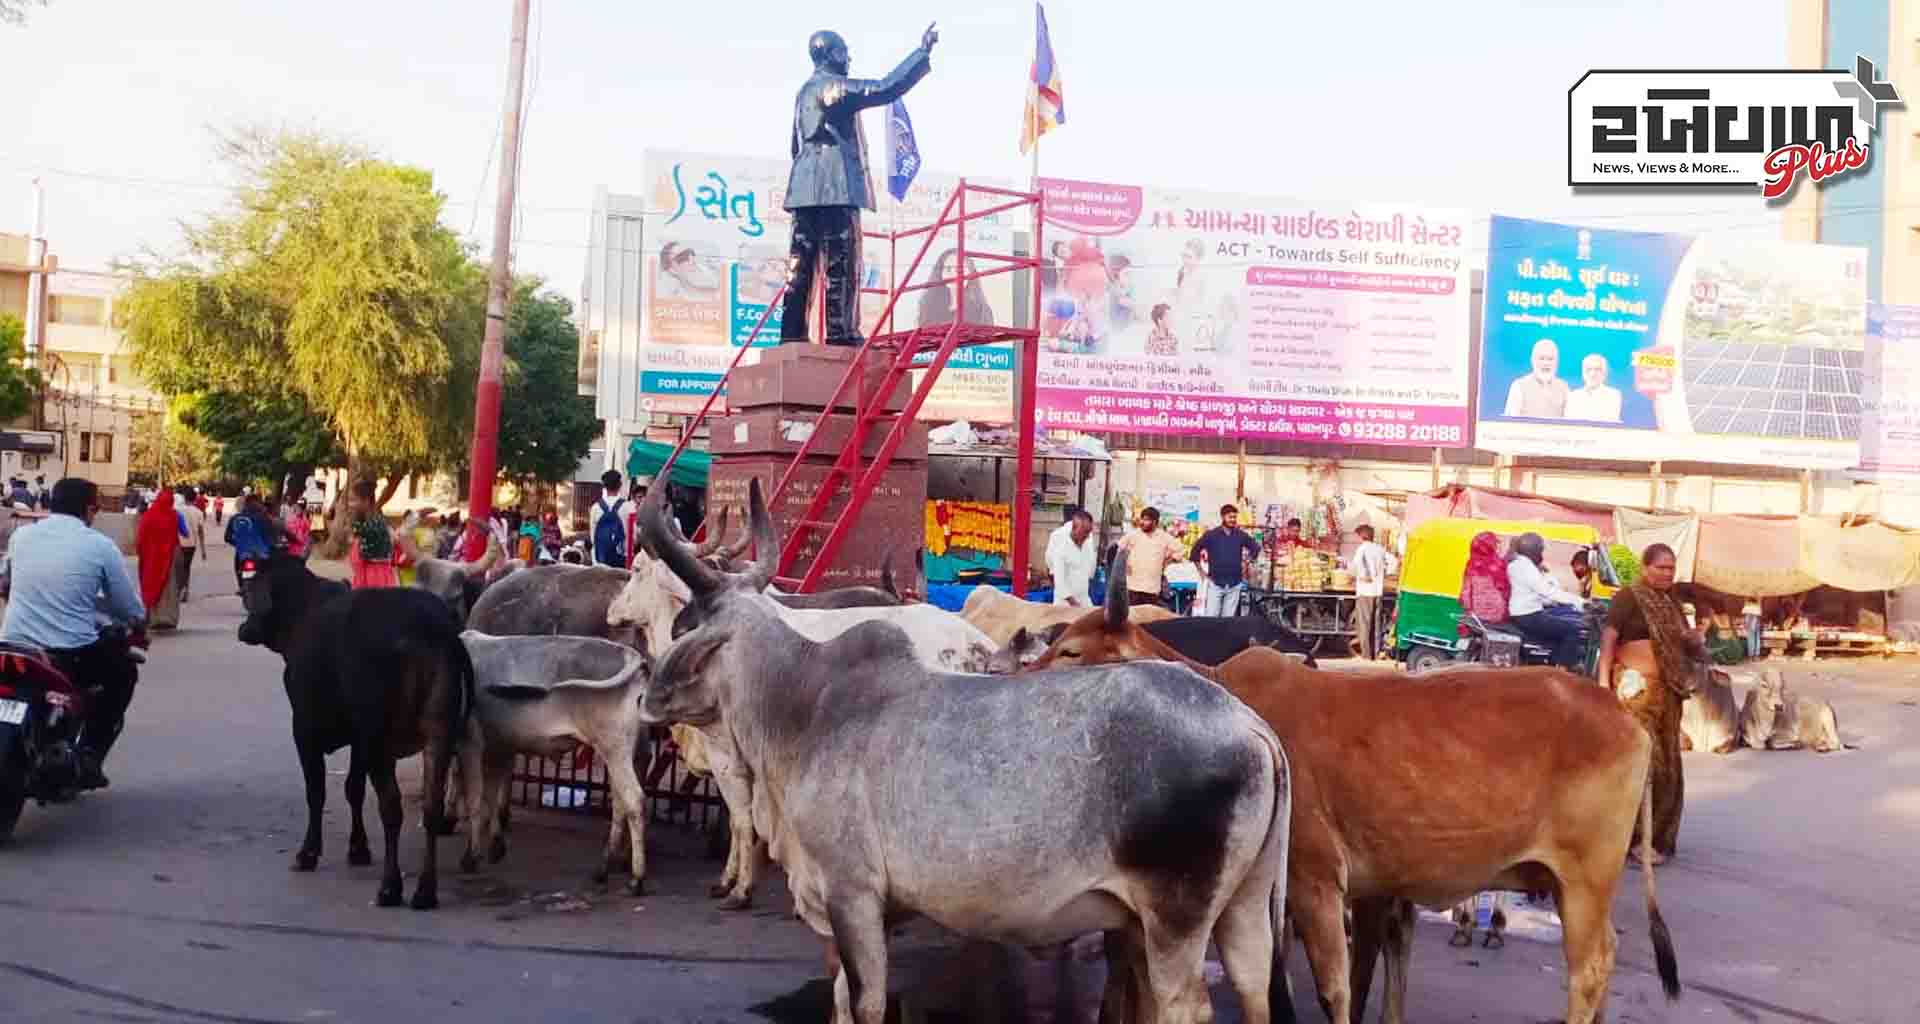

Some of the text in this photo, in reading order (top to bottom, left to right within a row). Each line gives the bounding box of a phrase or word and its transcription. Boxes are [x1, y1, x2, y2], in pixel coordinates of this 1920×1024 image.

[695, 171, 764, 237] સેતુ
[1216, 242, 1250, 257] ACT
[1266, 244, 1334, 264] Towards
[1338, 247, 1369, 264] Self
[1374, 249, 1462, 271] Sufficiency
[658, 379, 679, 389] FOR
[1410, 425, 1461, 442] 20188
